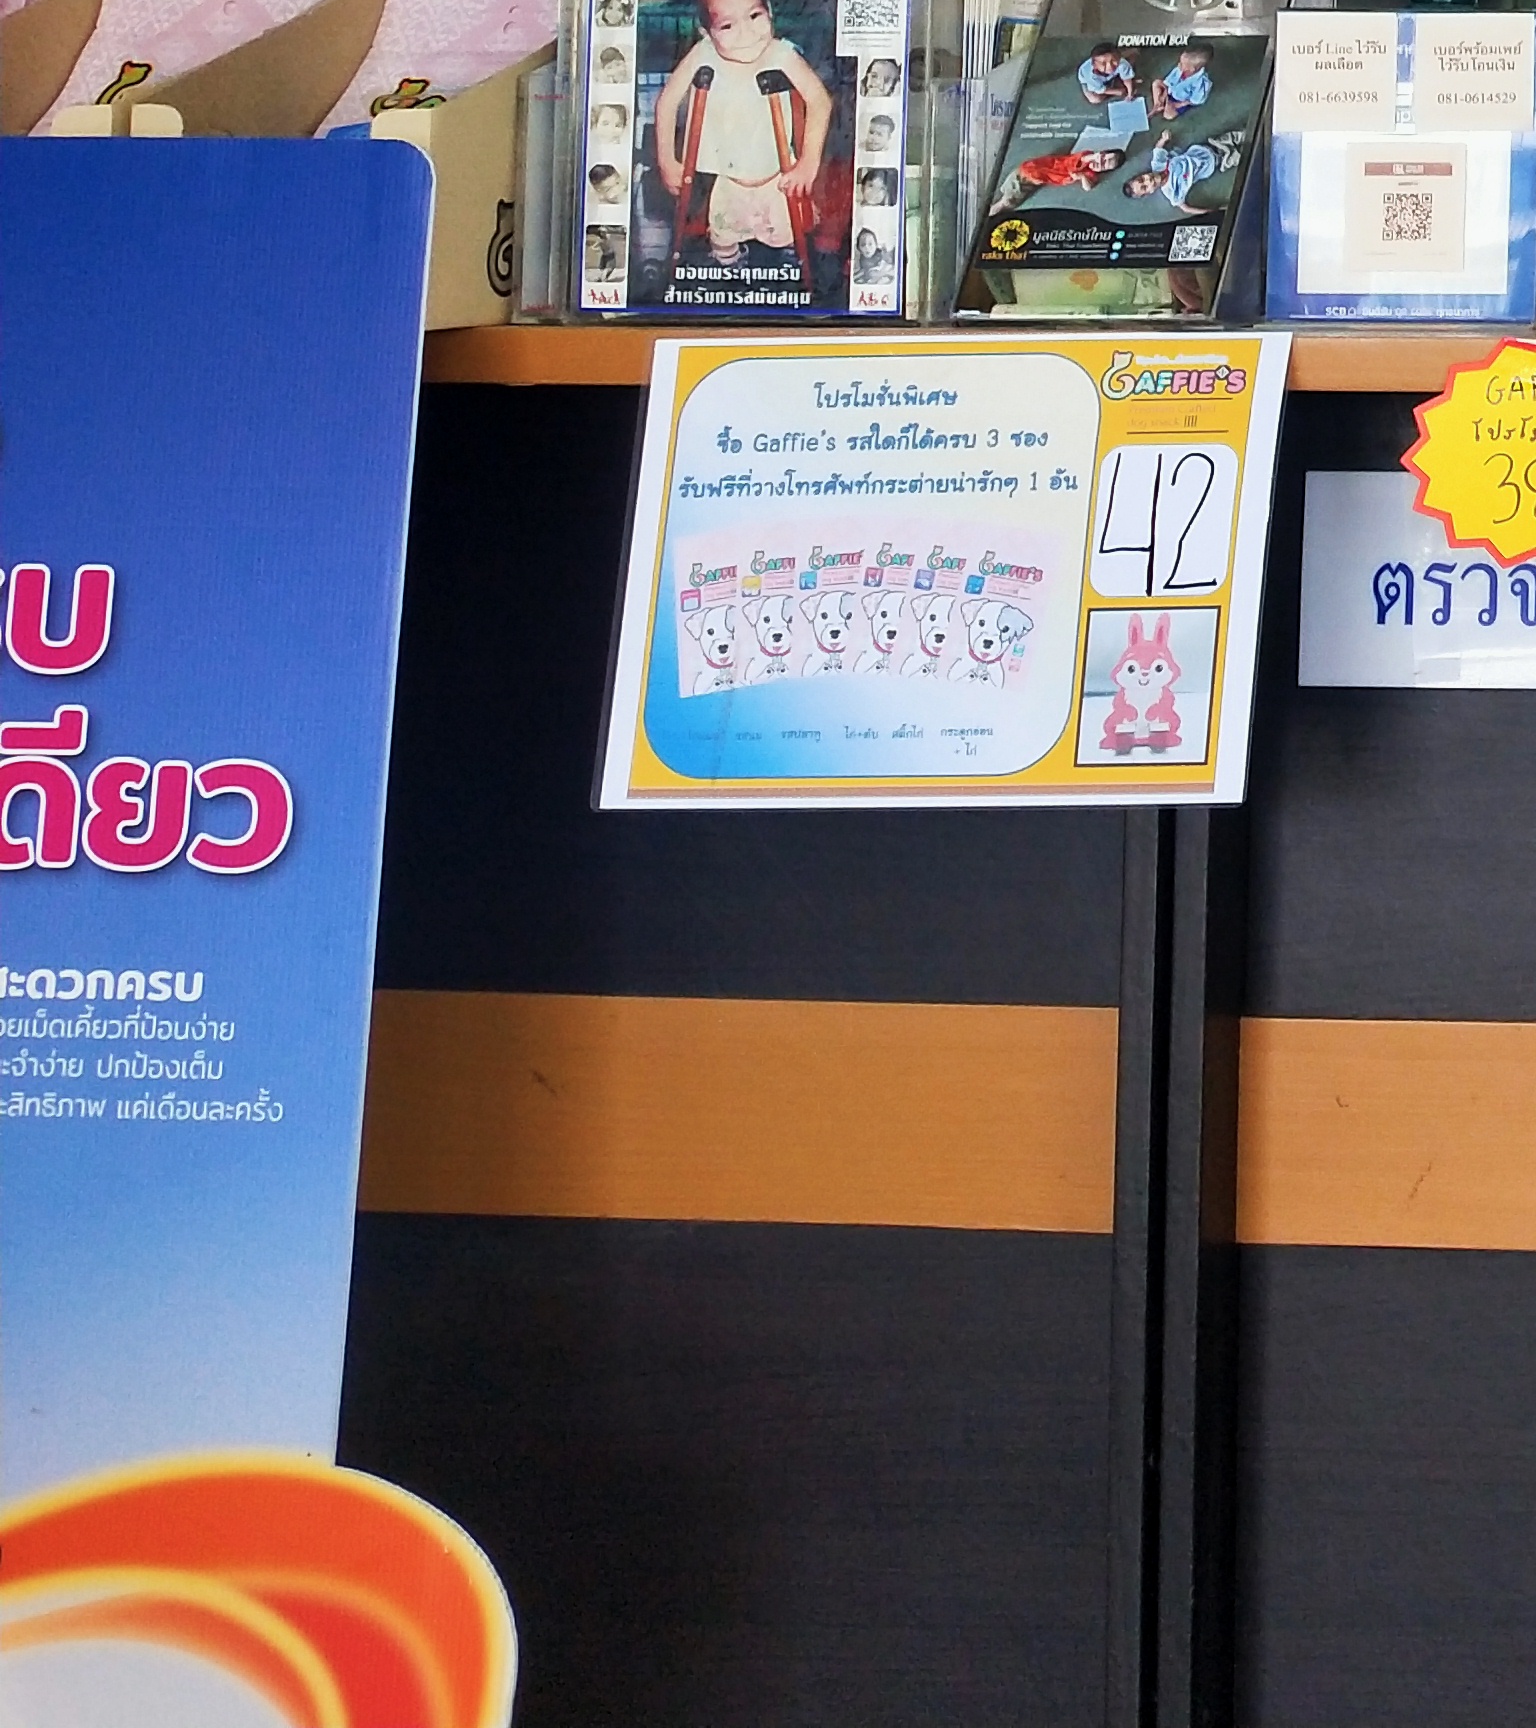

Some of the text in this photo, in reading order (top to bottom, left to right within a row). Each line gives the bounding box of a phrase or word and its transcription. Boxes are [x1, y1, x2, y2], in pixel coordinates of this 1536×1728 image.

[1118, 34, 1190, 47] DONATION BOX
[1292, 39, 1324, 55] เบอร์
[1326, 41, 1353, 55] Line
[1355, 39, 1387, 55] ไว้รับ
[1433, 40, 1524, 56] เบอร์พร้อมเพย์
[1314, 57, 1364, 70] ผลเลือด
[1298, 91, 1379, 104] 081-6639598
[1437, 92, 1517, 105] 081-0614529
[1032, 227, 1113, 246] มูลนิธิรักษ์ไทย
[674, 265, 801, 285] ขอบพระคุณครับ
[663, 285, 812, 309] สำหรับการสนับสนุน
[1101, 350, 1247, 400] GAFFIE'S
[813, 379, 958, 408] โปรโมชั่นพิเศษ
[716, 426, 743, 454] ซื้อ
[752, 429, 837, 454] Gaffie's
[846, 422, 977, 451] รสใดก็ได้ครบ
[985, 428, 1001, 450] 3
[678, 468, 1078, 499] รับฟรีที่วางโทรศัพท์กระต่ายน่ารักๆ 1 อัน
[1098, 452, 1218, 597] 42
[97, 1050, 224, 1080] ปกป้องเต็ม
[116, 1087, 284, 1122] แค่เดือนละครั้ง
